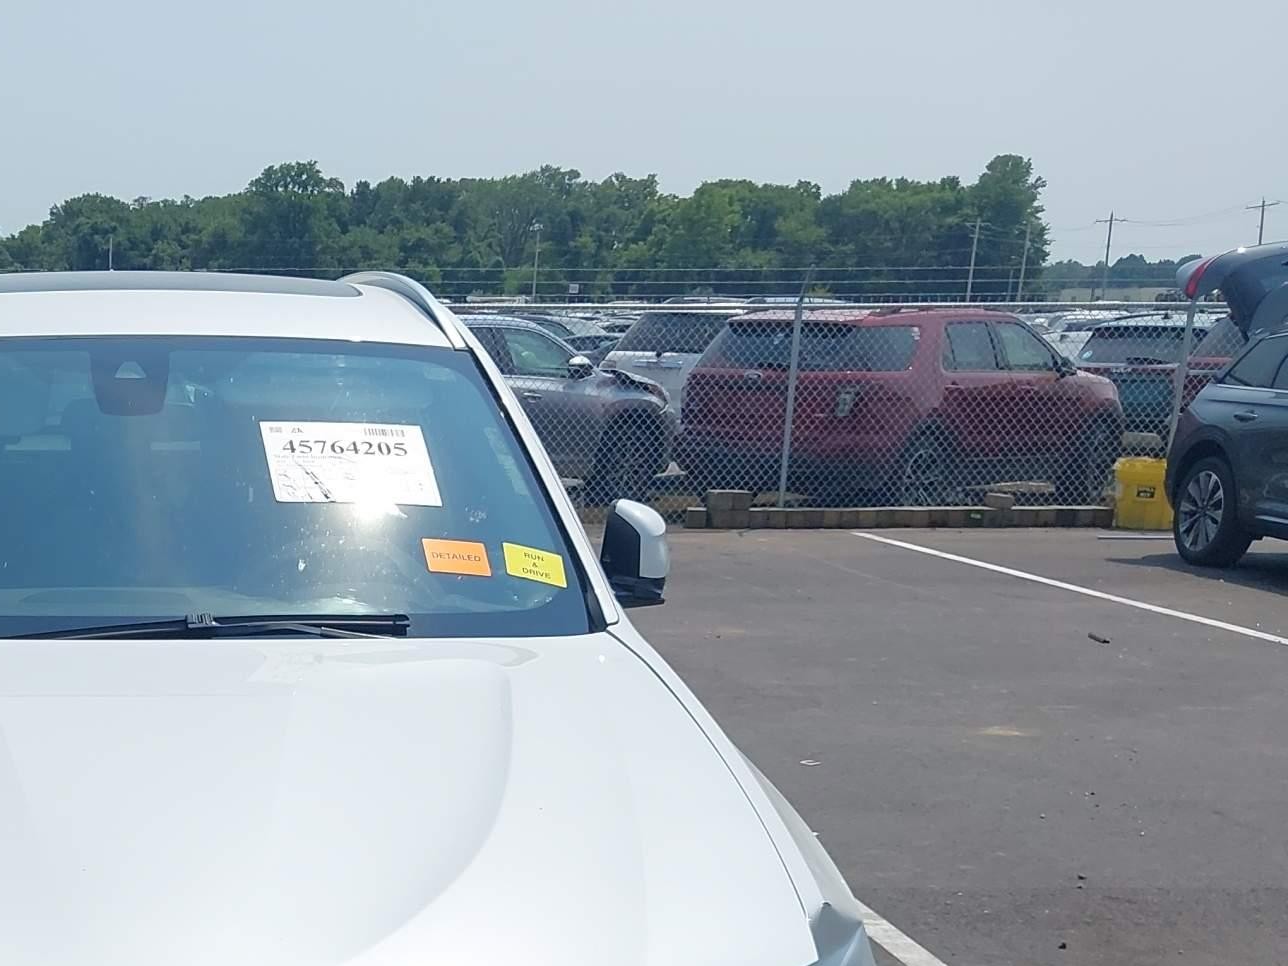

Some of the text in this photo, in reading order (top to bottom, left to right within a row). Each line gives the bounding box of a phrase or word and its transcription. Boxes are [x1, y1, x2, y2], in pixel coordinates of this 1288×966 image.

[282, 439, 408, 457] 45764205
[431, 551, 481, 562] DETAILED
[524, 552, 544, 562] RUN
[522, 567, 552, 579] DRIVE
